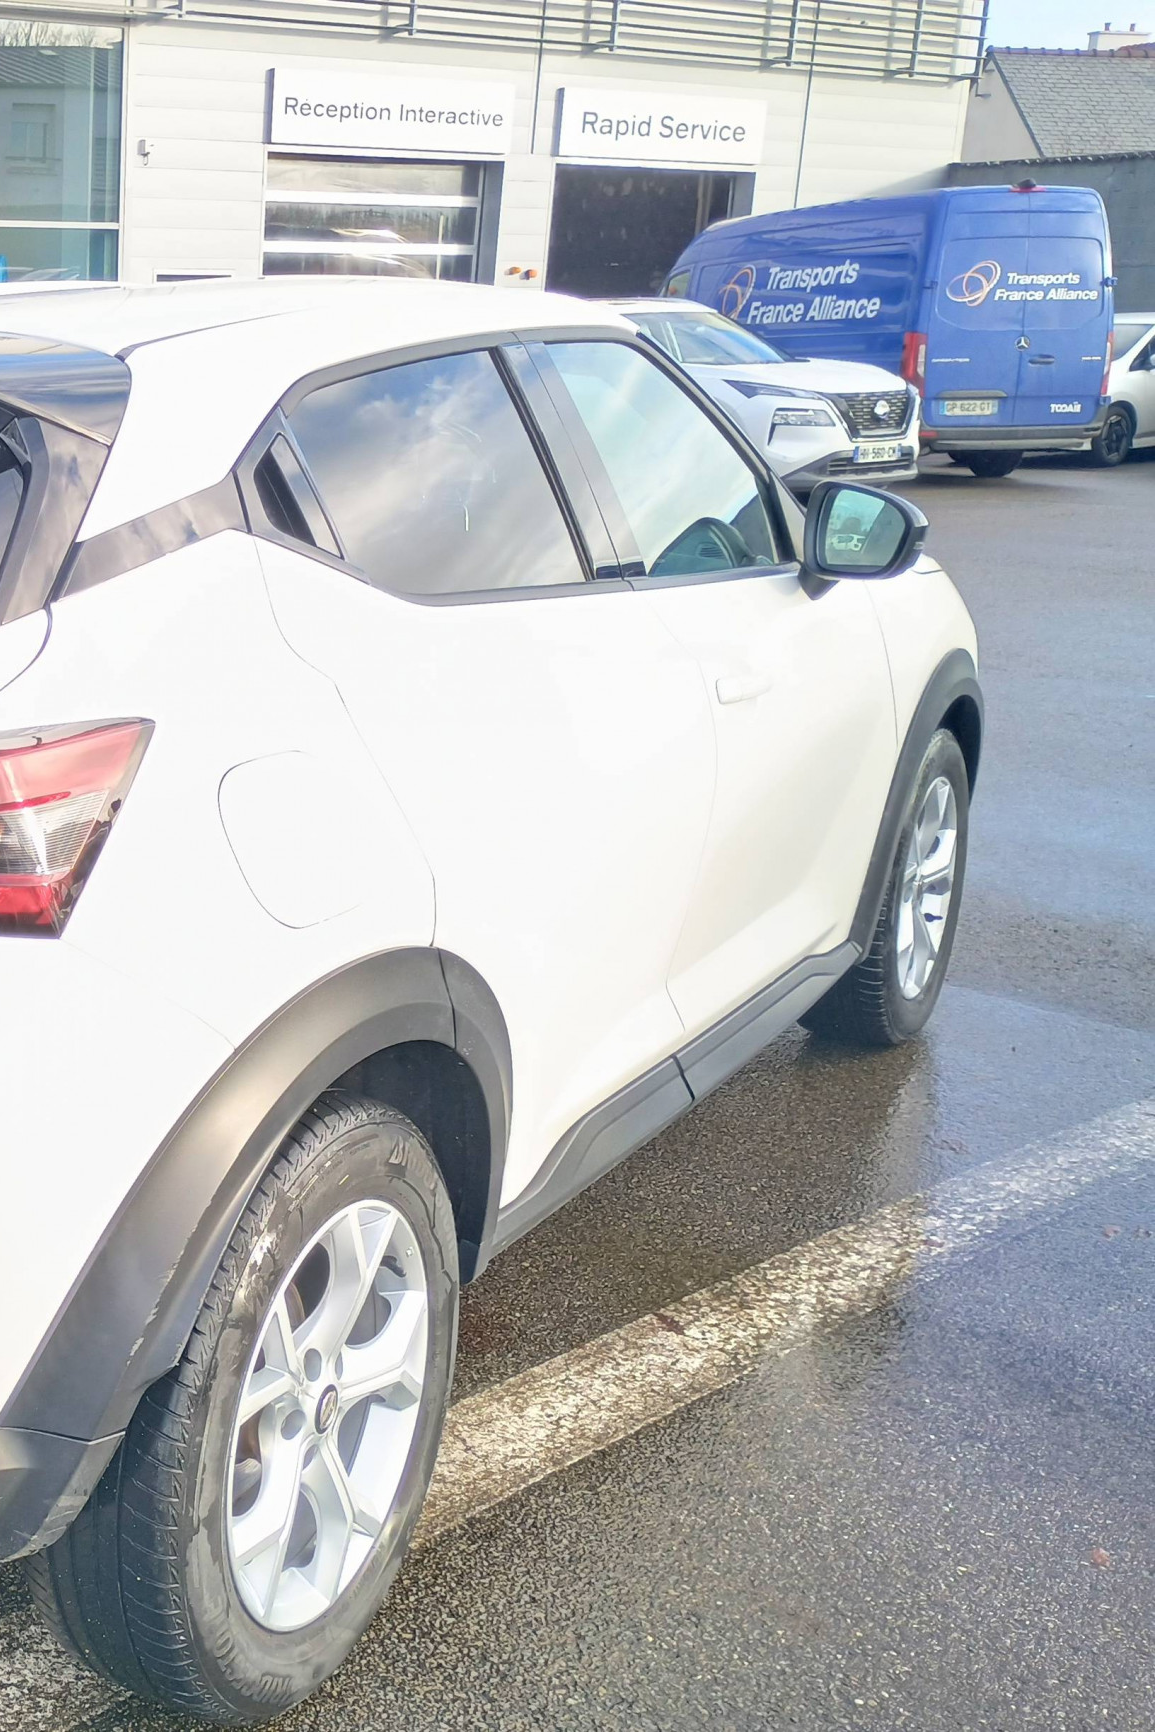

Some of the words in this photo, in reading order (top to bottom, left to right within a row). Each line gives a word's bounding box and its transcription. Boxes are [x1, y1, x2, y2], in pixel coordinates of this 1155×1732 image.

[399, 104, 504, 127] Interactive
[581, 111, 652, 141] Rapid
[658, 115, 746, 142] Service
[767, 259, 860, 293] Transports
[1007, 272, 1081, 286] Transports
[994, 289, 1044, 301] France
[1046, 287, 1098, 300] Alliance
[747, 301, 804, 324] France
[805, 295, 880, 321] Alliance
